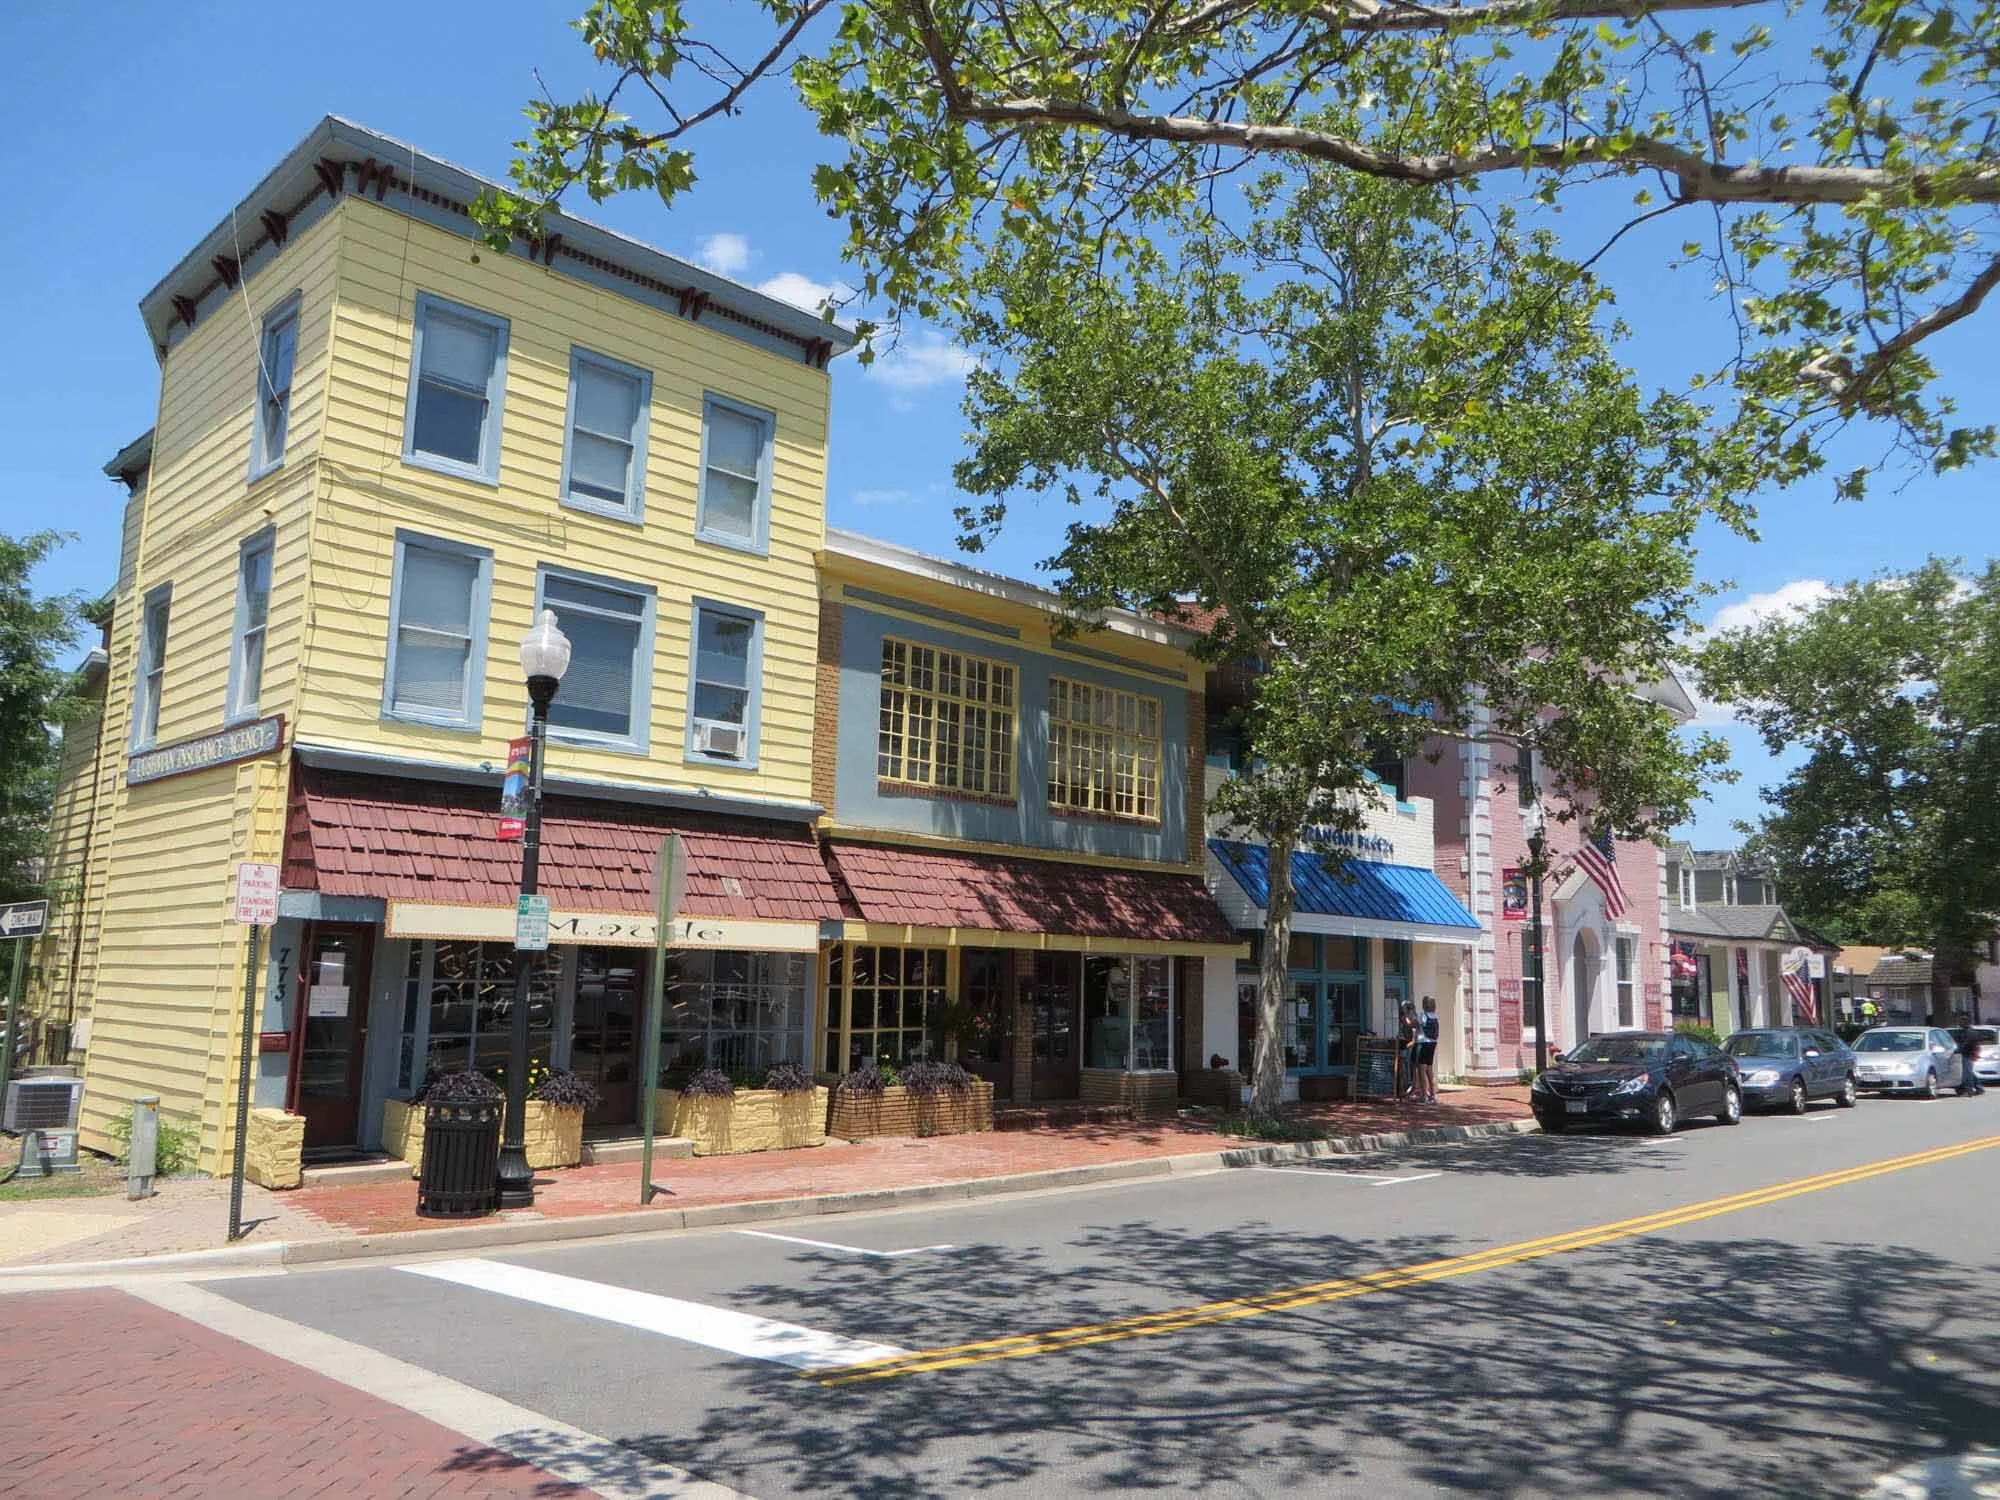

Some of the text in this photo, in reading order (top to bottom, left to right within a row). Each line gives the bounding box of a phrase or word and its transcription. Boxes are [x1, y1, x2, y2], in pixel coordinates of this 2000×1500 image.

[226, 726, 265, 755] AGENCY
[254, 870, 265, 878] NO
[243, 880, 273, 888] PARKING
[241, 896, 274, 905] STANDING
[240, 906, 274, 918] FIRE LANE
[11, 911, 41, 926] ONE WAY
[275, 948, 290, 1001] 773
